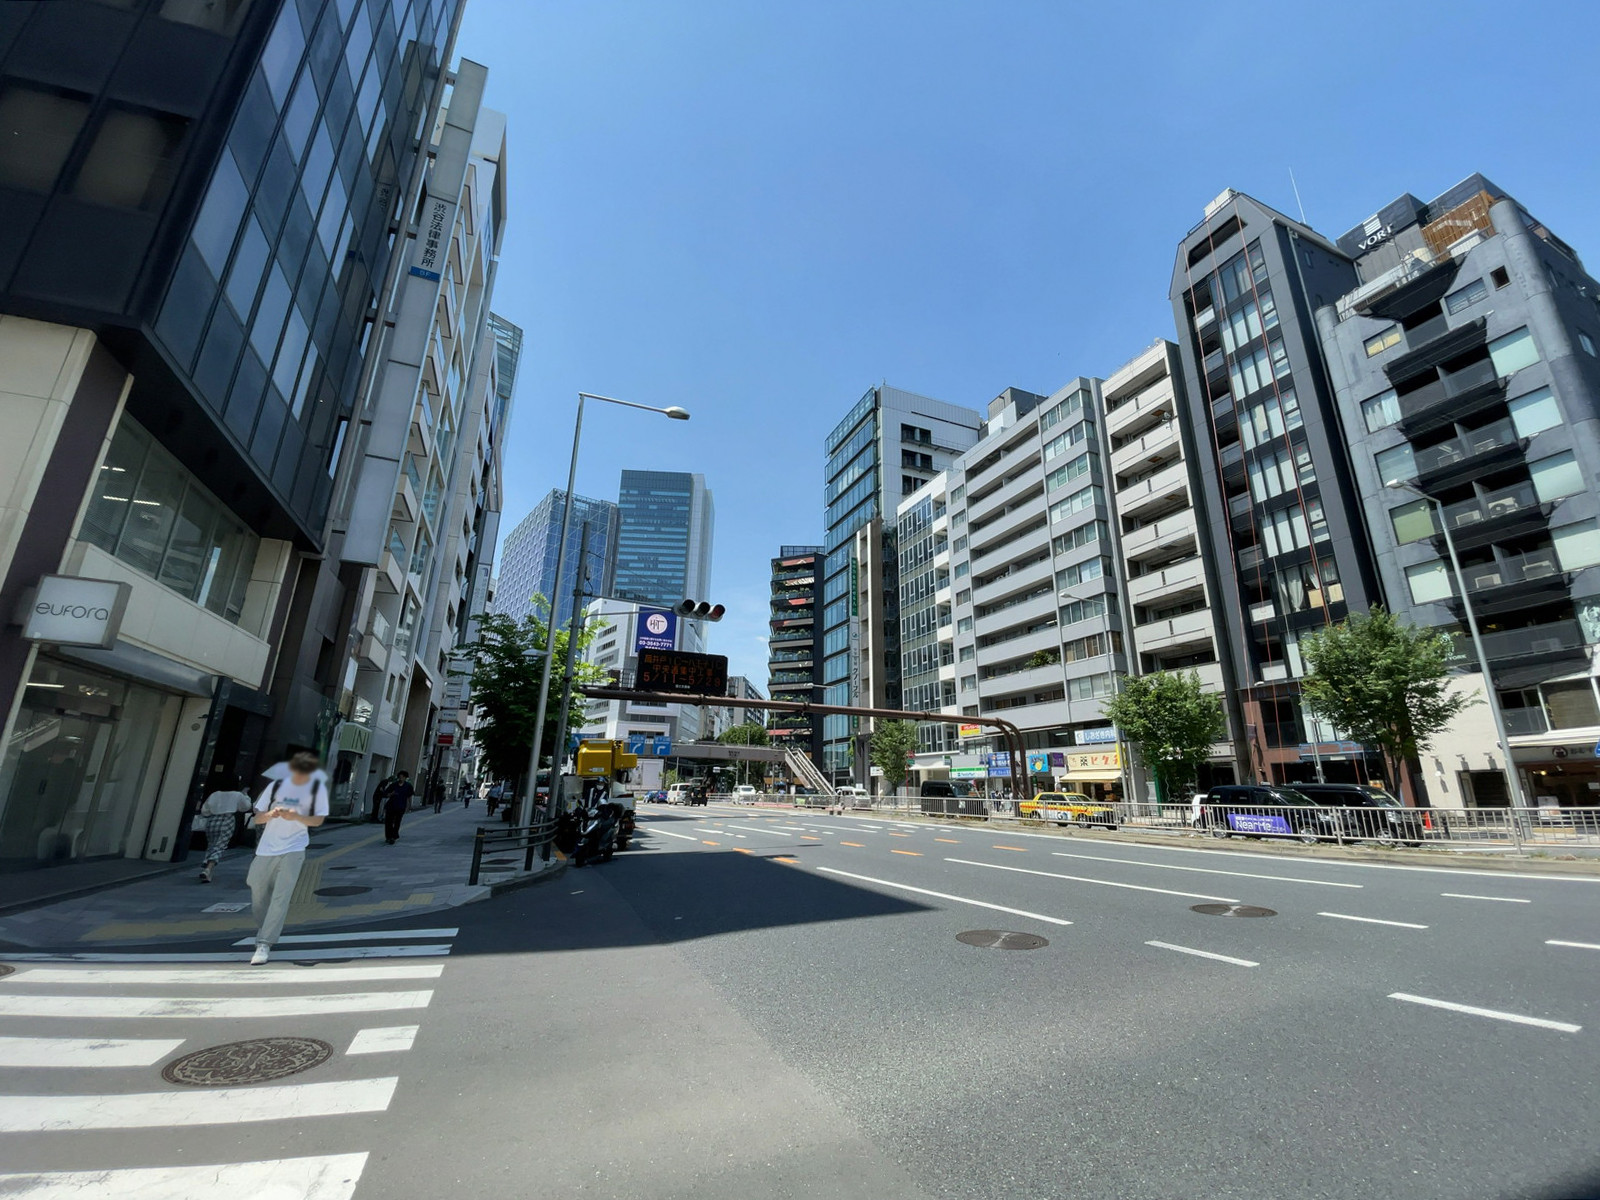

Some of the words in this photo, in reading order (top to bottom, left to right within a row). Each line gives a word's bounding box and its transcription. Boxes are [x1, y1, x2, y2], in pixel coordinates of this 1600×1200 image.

[421, 202, 447, 268] 渋谷法律事務所
[1358, 223, 1393, 250] VORT
[35, 601, 109, 621] eufora
